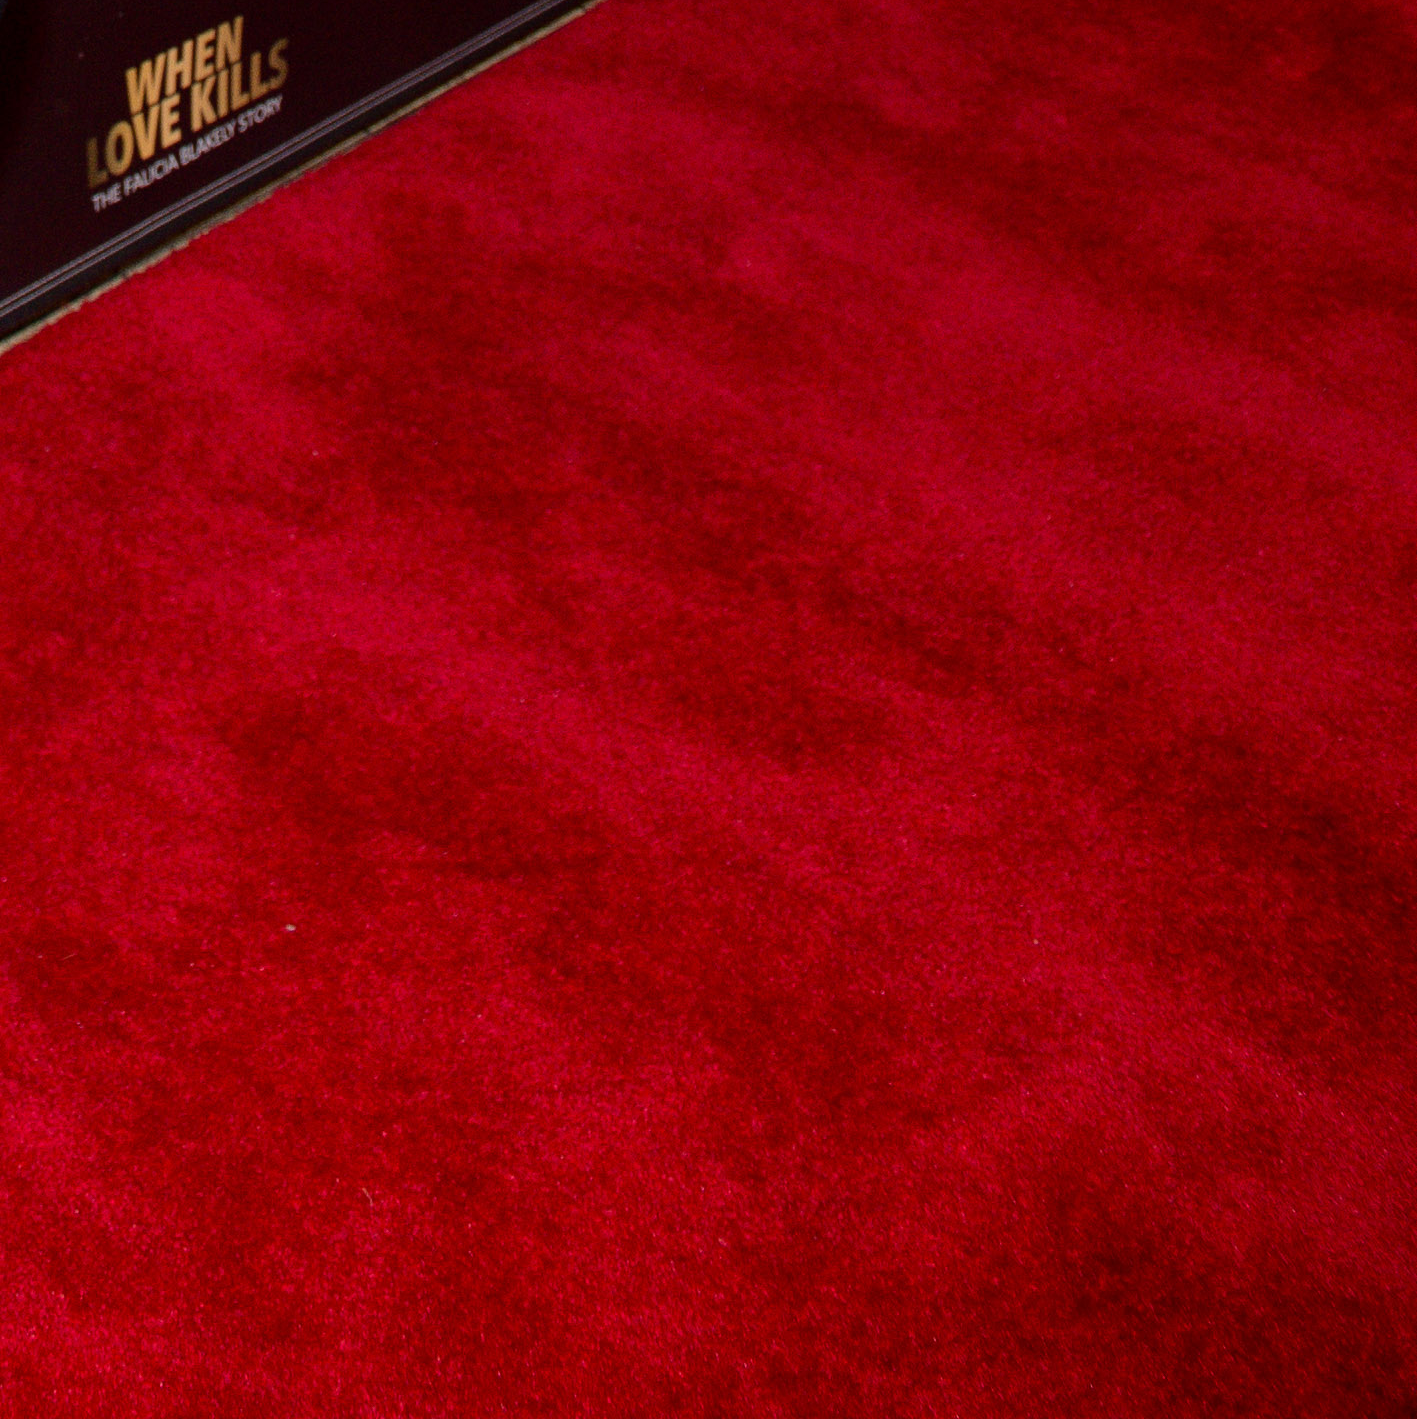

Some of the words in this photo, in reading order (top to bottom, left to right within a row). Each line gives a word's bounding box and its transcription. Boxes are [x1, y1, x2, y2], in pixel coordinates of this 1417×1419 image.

[88, 94, 181, 189] LOVE
[193, 38, 288, 133] KILLS
[126, 14, 240, 116] WHEN
[90, 184, 119, 211] THE
[123, 155, 175, 195] FALICIA
[179, 120, 235, 165] BLAKELY
[239, 95, 281, 132] STORY
